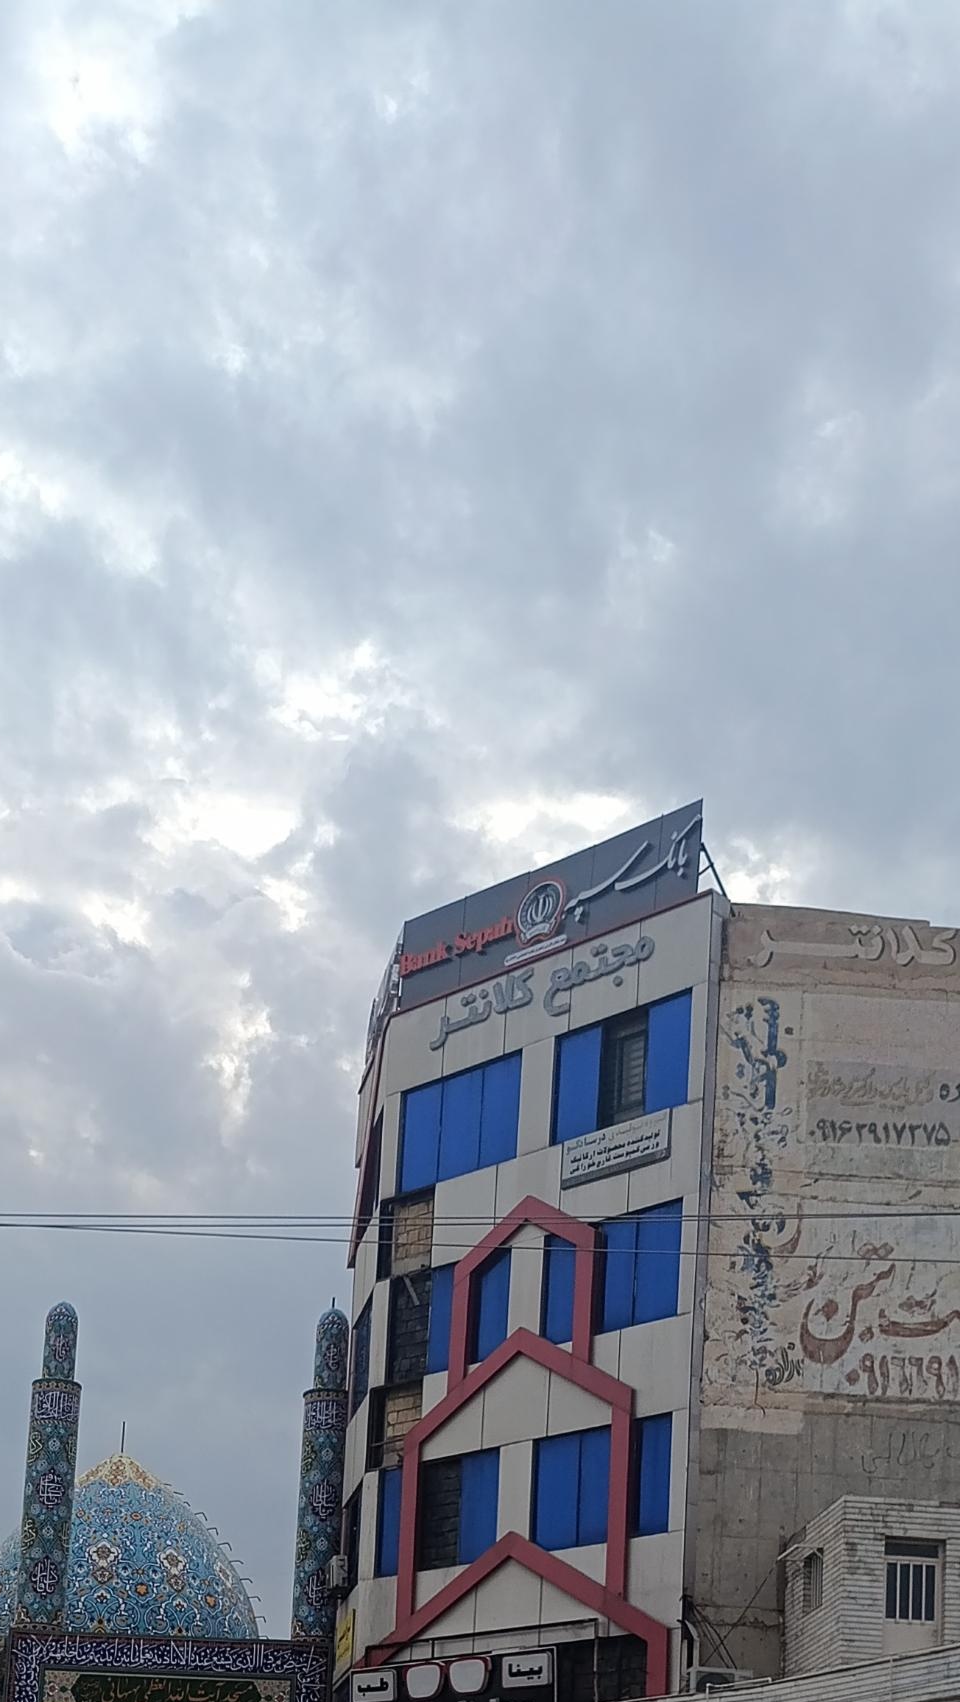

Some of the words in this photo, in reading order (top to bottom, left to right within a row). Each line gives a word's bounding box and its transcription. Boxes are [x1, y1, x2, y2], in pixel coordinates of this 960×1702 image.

[562, 841, 649, 922] سپه
[614, 815, 702, 890] بانک
[400, 942, 449, 977] Bank
[454, 917, 515, 954] Sepah
[543, 937, 656, 1017] مجتمع
[430, 967, 534, 1051] کلانتر
[357, 1676, 389, 1698] طب
[507, 1662, 544, 1681] بینا
